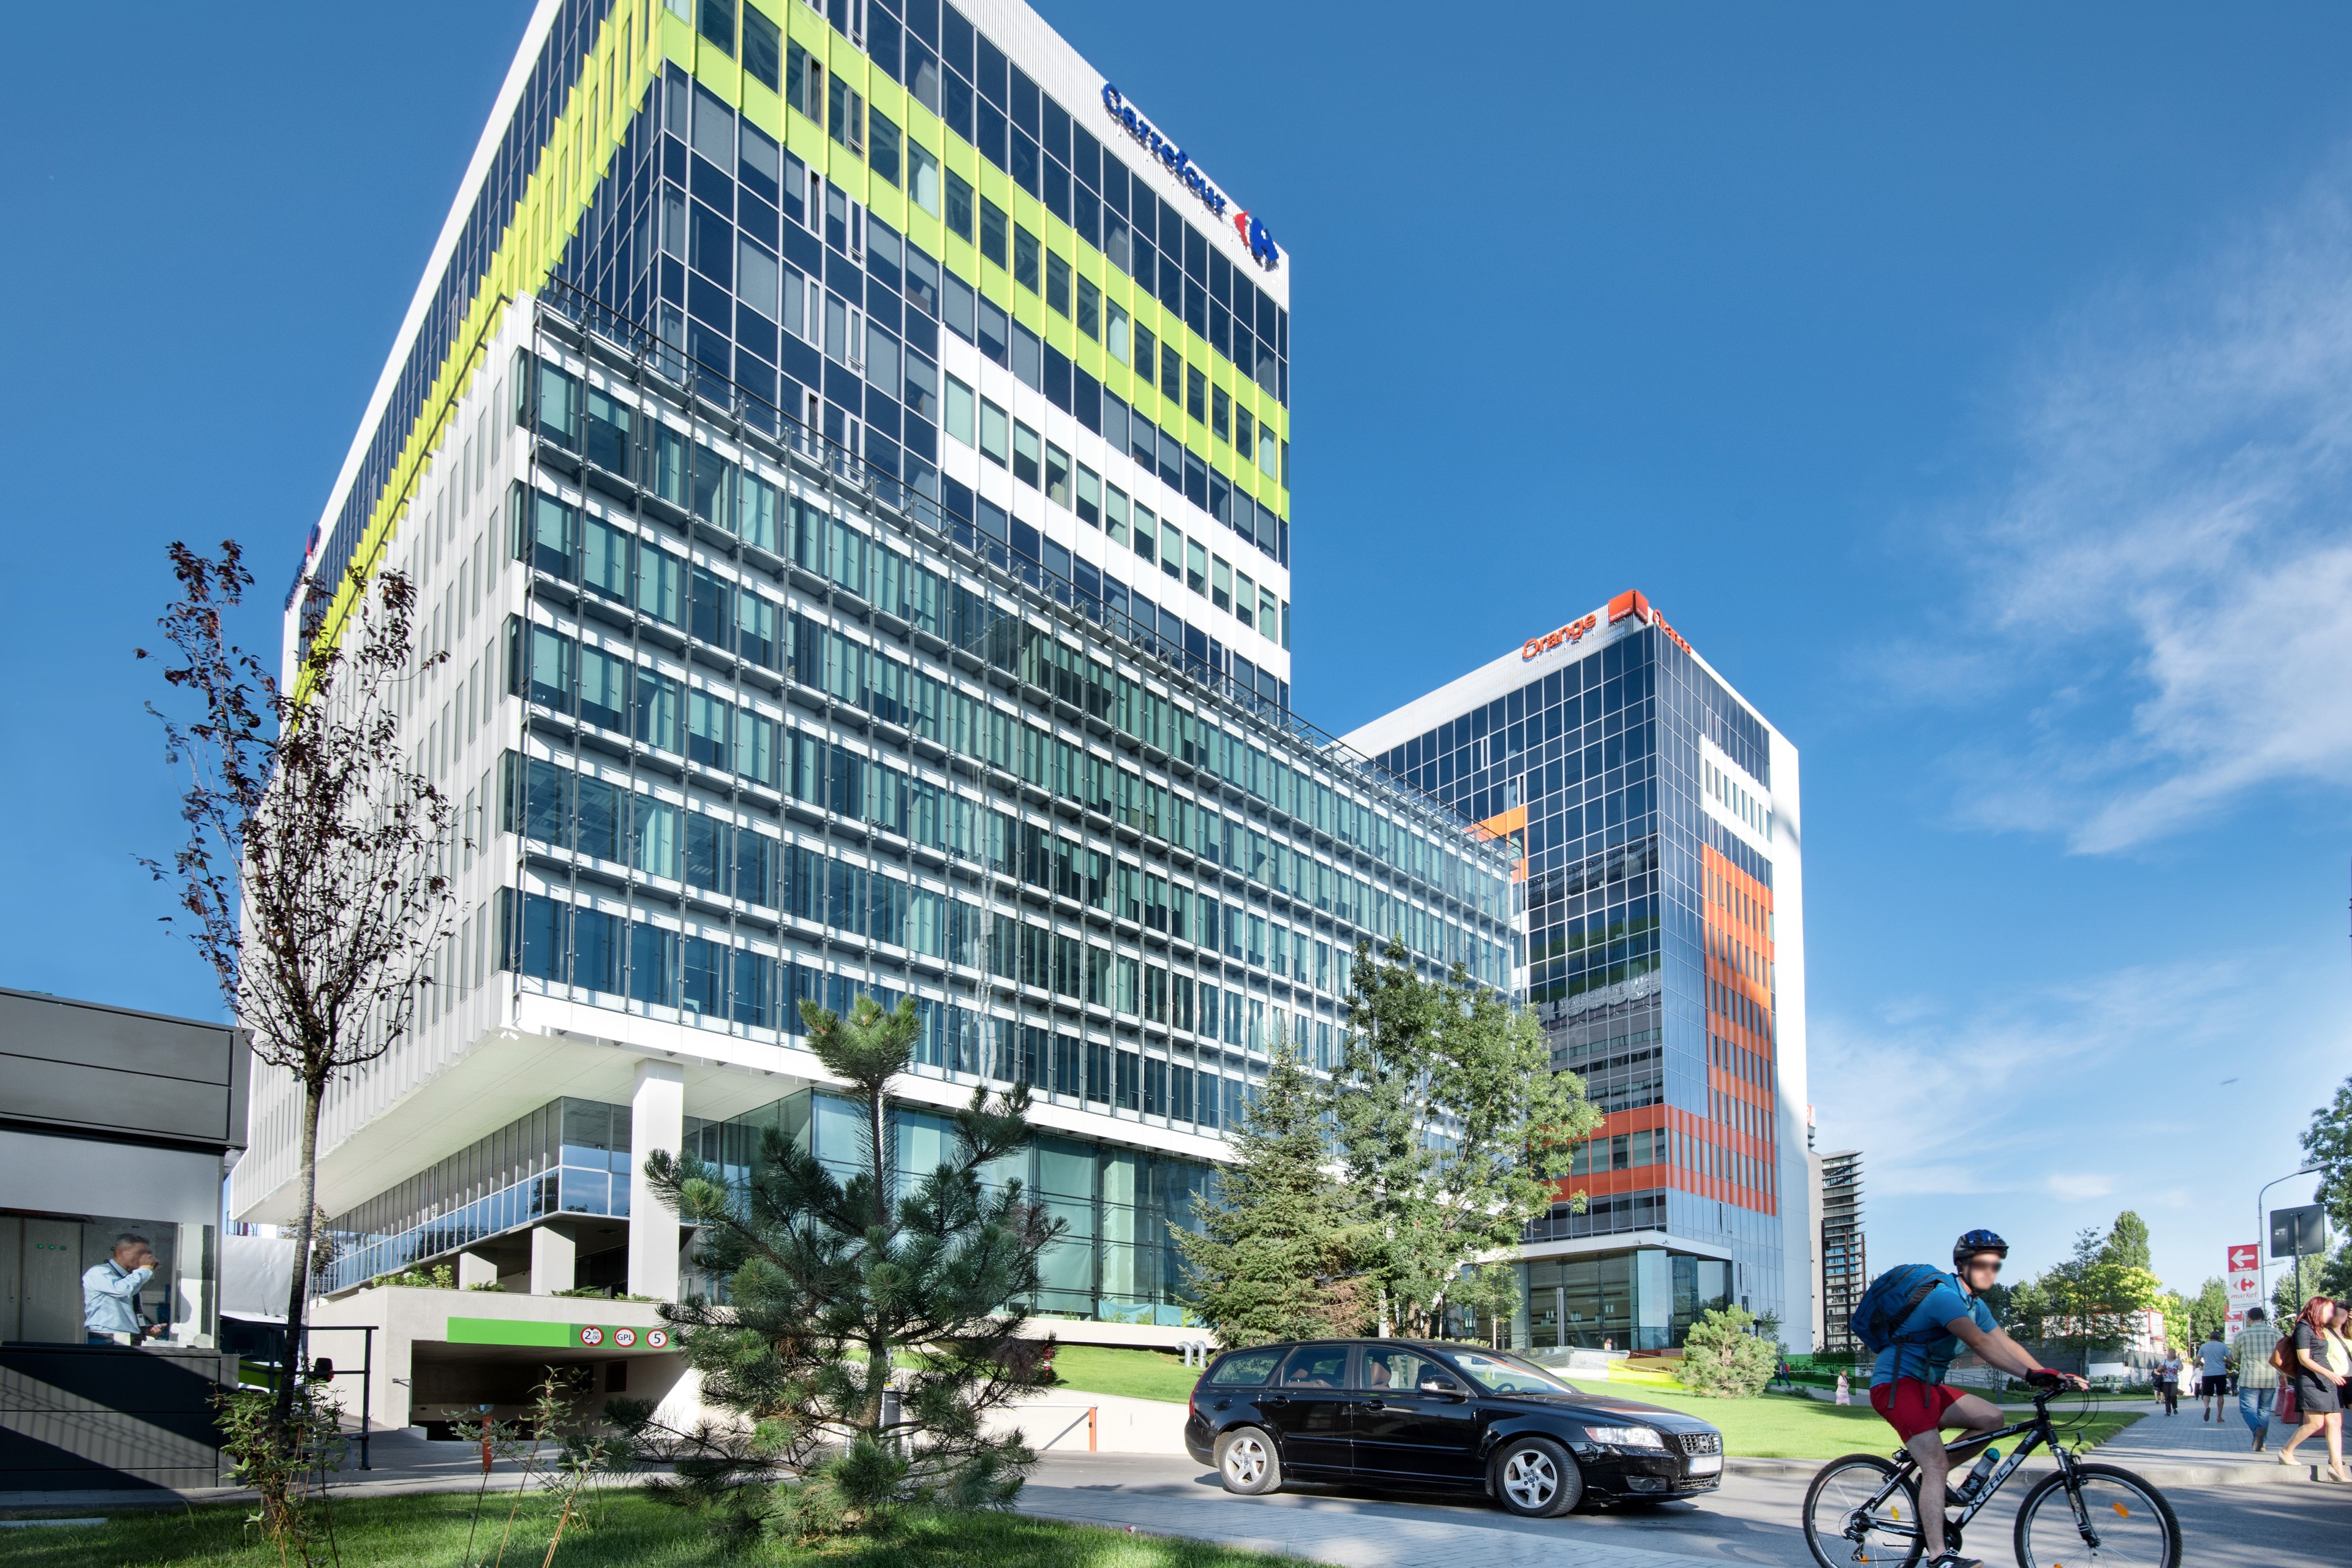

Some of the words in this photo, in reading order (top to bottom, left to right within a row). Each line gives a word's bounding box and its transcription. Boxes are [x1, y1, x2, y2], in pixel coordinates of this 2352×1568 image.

[1102, 83, 1227, 214] Carrefour
[1522, 613, 1597, 659] Orange
[1610, 607, 1631, 620] orange
[654, 1333, 661, 1344] 5
[1970, 1455, 2015, 1512] X-FACT
